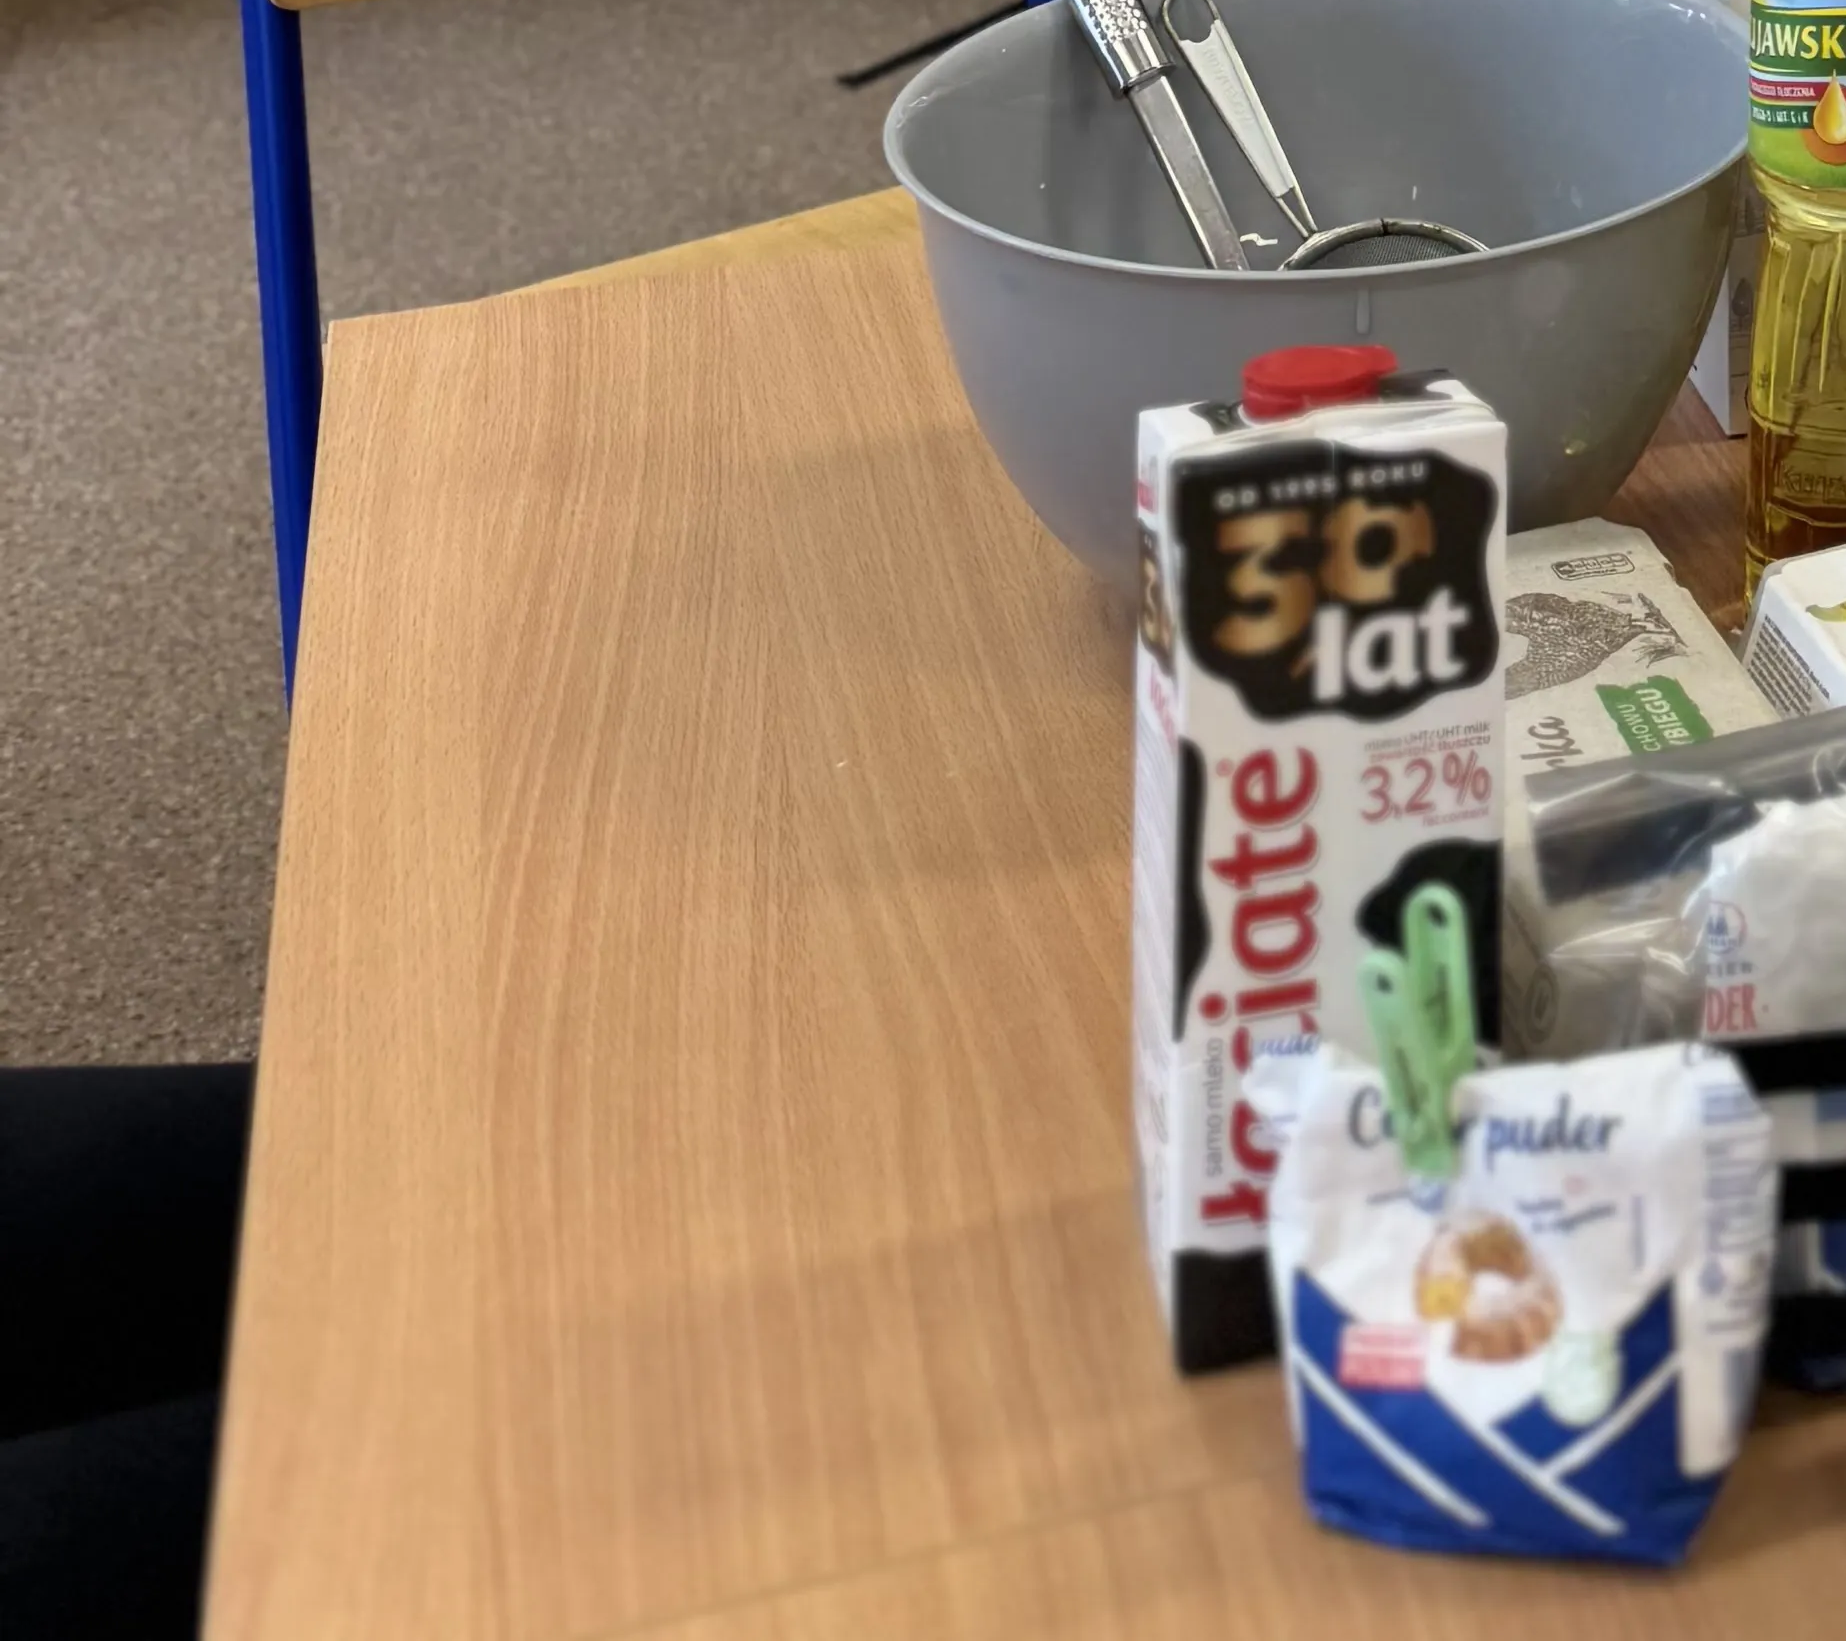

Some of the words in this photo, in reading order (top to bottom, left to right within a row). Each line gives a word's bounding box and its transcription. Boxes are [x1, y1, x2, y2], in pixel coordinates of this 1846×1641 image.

[1215, 487, 1256, 509] OD
[1270, 475, 1336, 501] 1995
[1348, 461, 1428, 489] ROKU
[1313, 586, 1471, 702] lat
[1464, 720, 1490, 734] milk
[1617, 704, 1662, 752] CHOWU
[1360, 749, 1492, 825] 3,2%
[1205, 1039, 1223, 1110] mleko
[1207, 1115, 1223, 1177] samo
